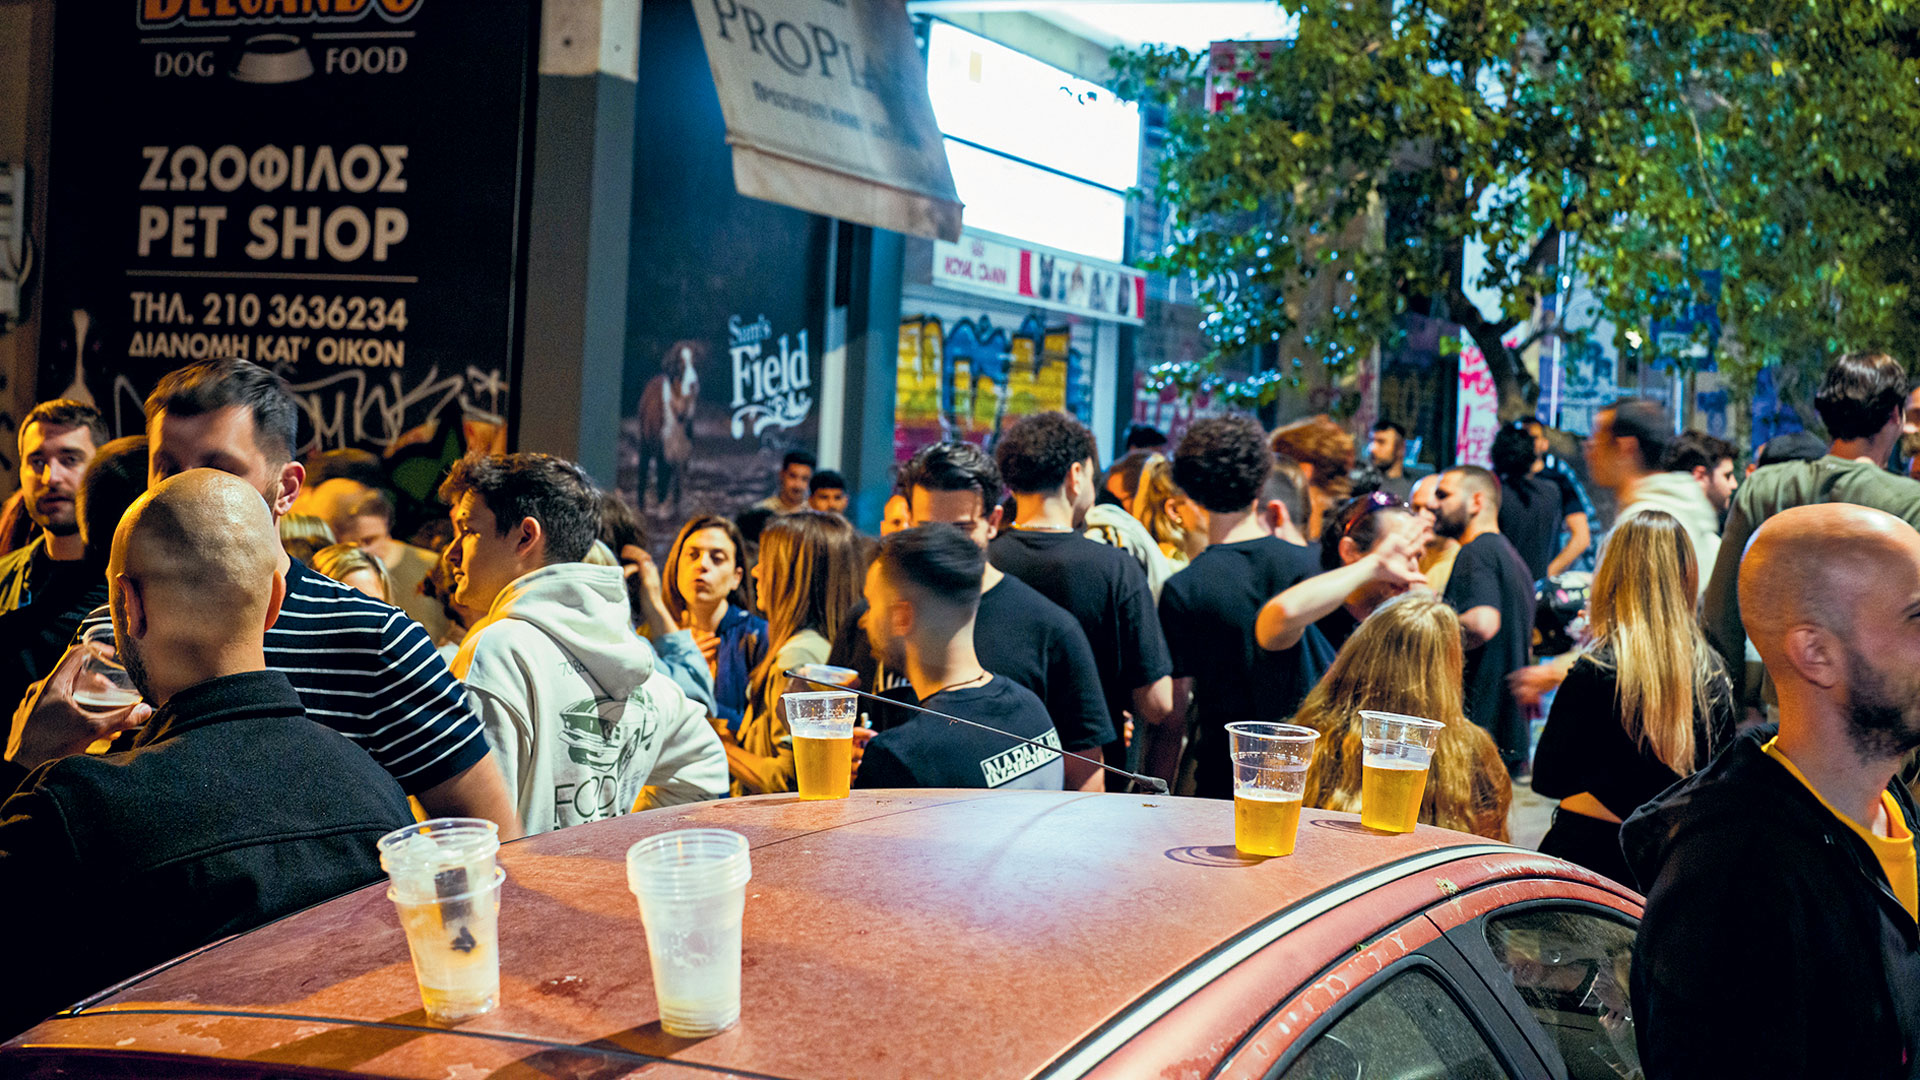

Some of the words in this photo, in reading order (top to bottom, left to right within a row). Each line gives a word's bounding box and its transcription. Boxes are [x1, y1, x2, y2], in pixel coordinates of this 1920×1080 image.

[154, 51, 214, 77] DOG
[325, 46, 408, 75] FOOD
[139, 144, 409, 193] ΖΩΟΦΙΛΟΣ
[137, 205, 228, 258] PET
[245, 204, 409, 262] SHOP
[130, 292, 194, 324] ΤΗΛ.
[203, 293, 261, 326] 210
[267, 294, 408, 332] 3636234
[128, 331, 249, 359] ΔΙΑΝΟΜΗ
[316, 337, 405, 368] ΟΙΚΟΝ
[729, 328, 811, 409] Field
